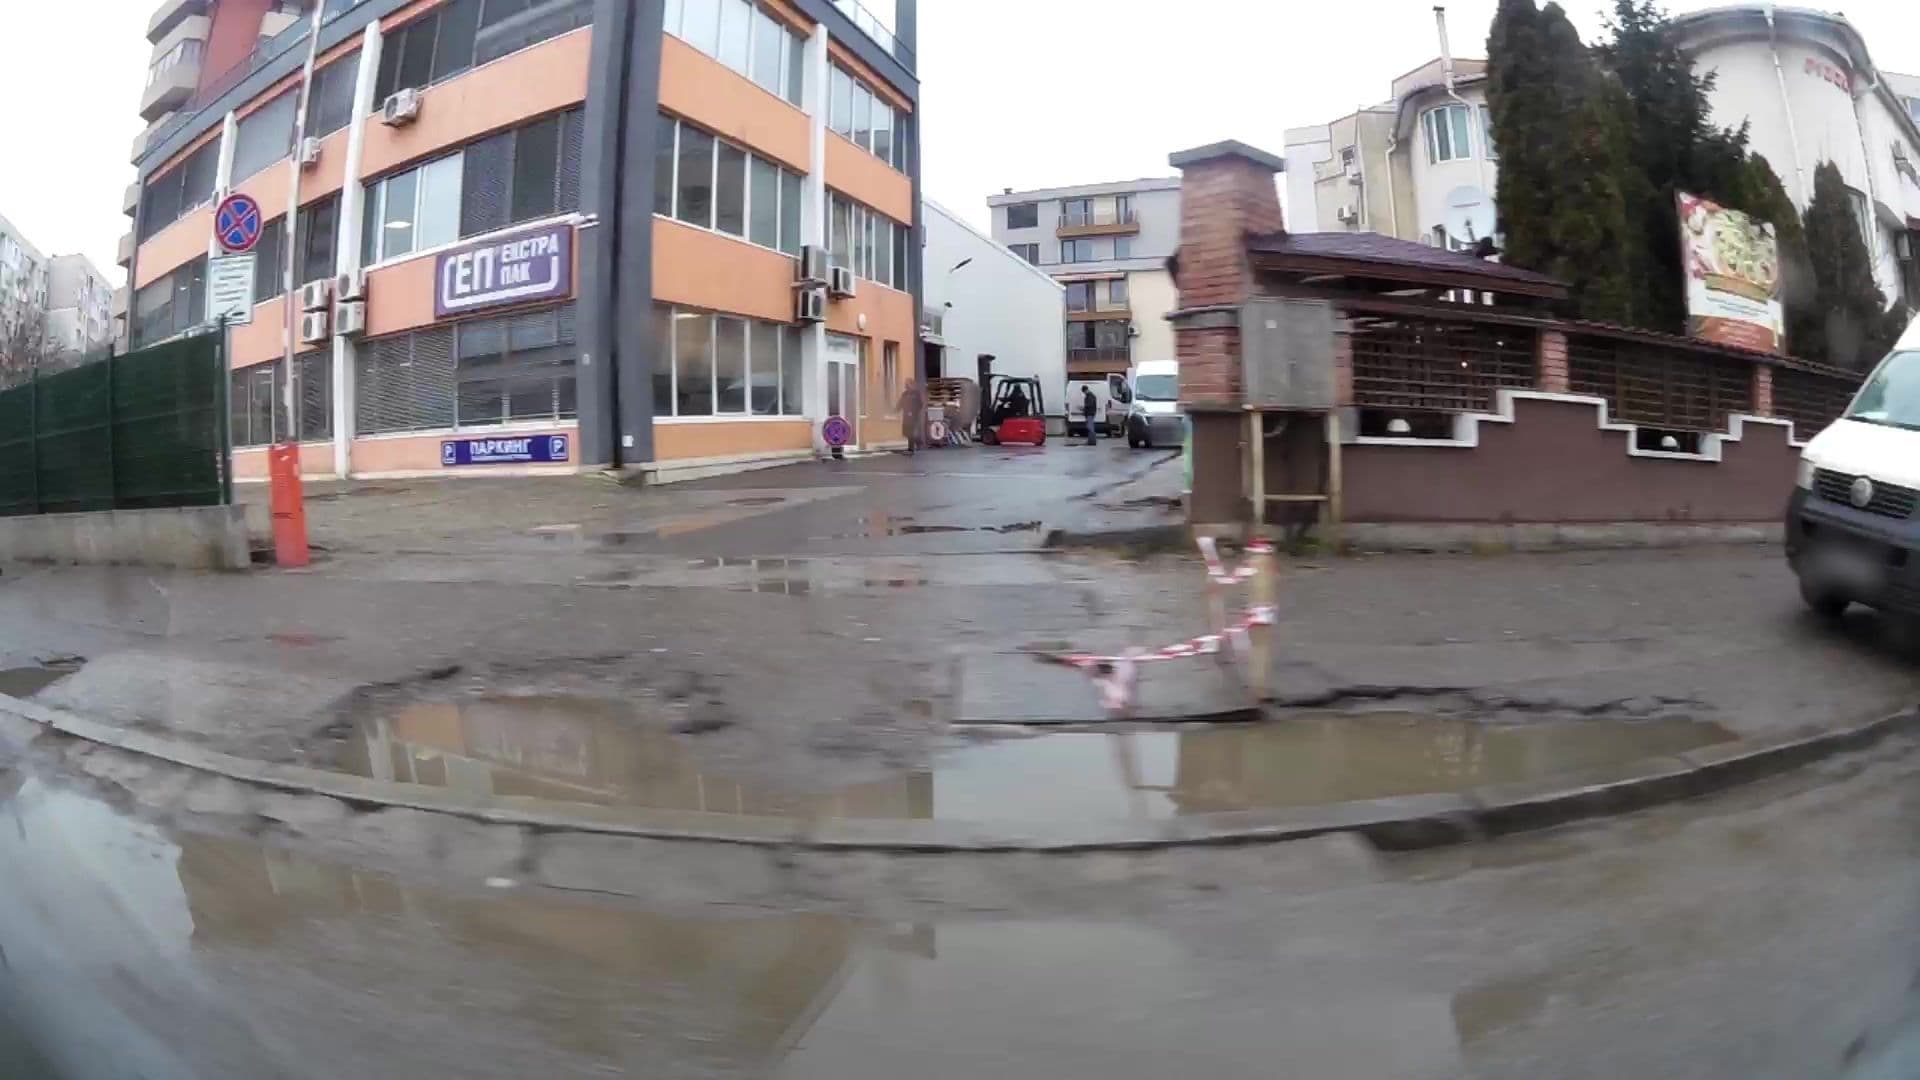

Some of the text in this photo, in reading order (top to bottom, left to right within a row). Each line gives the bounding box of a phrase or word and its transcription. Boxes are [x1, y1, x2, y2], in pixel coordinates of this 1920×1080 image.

[501, 233, 559, 264] ЕКСТРА
[500, 262, 532, 286] ПАК
[470, 438, 532, 455] ПАРКИНГ
